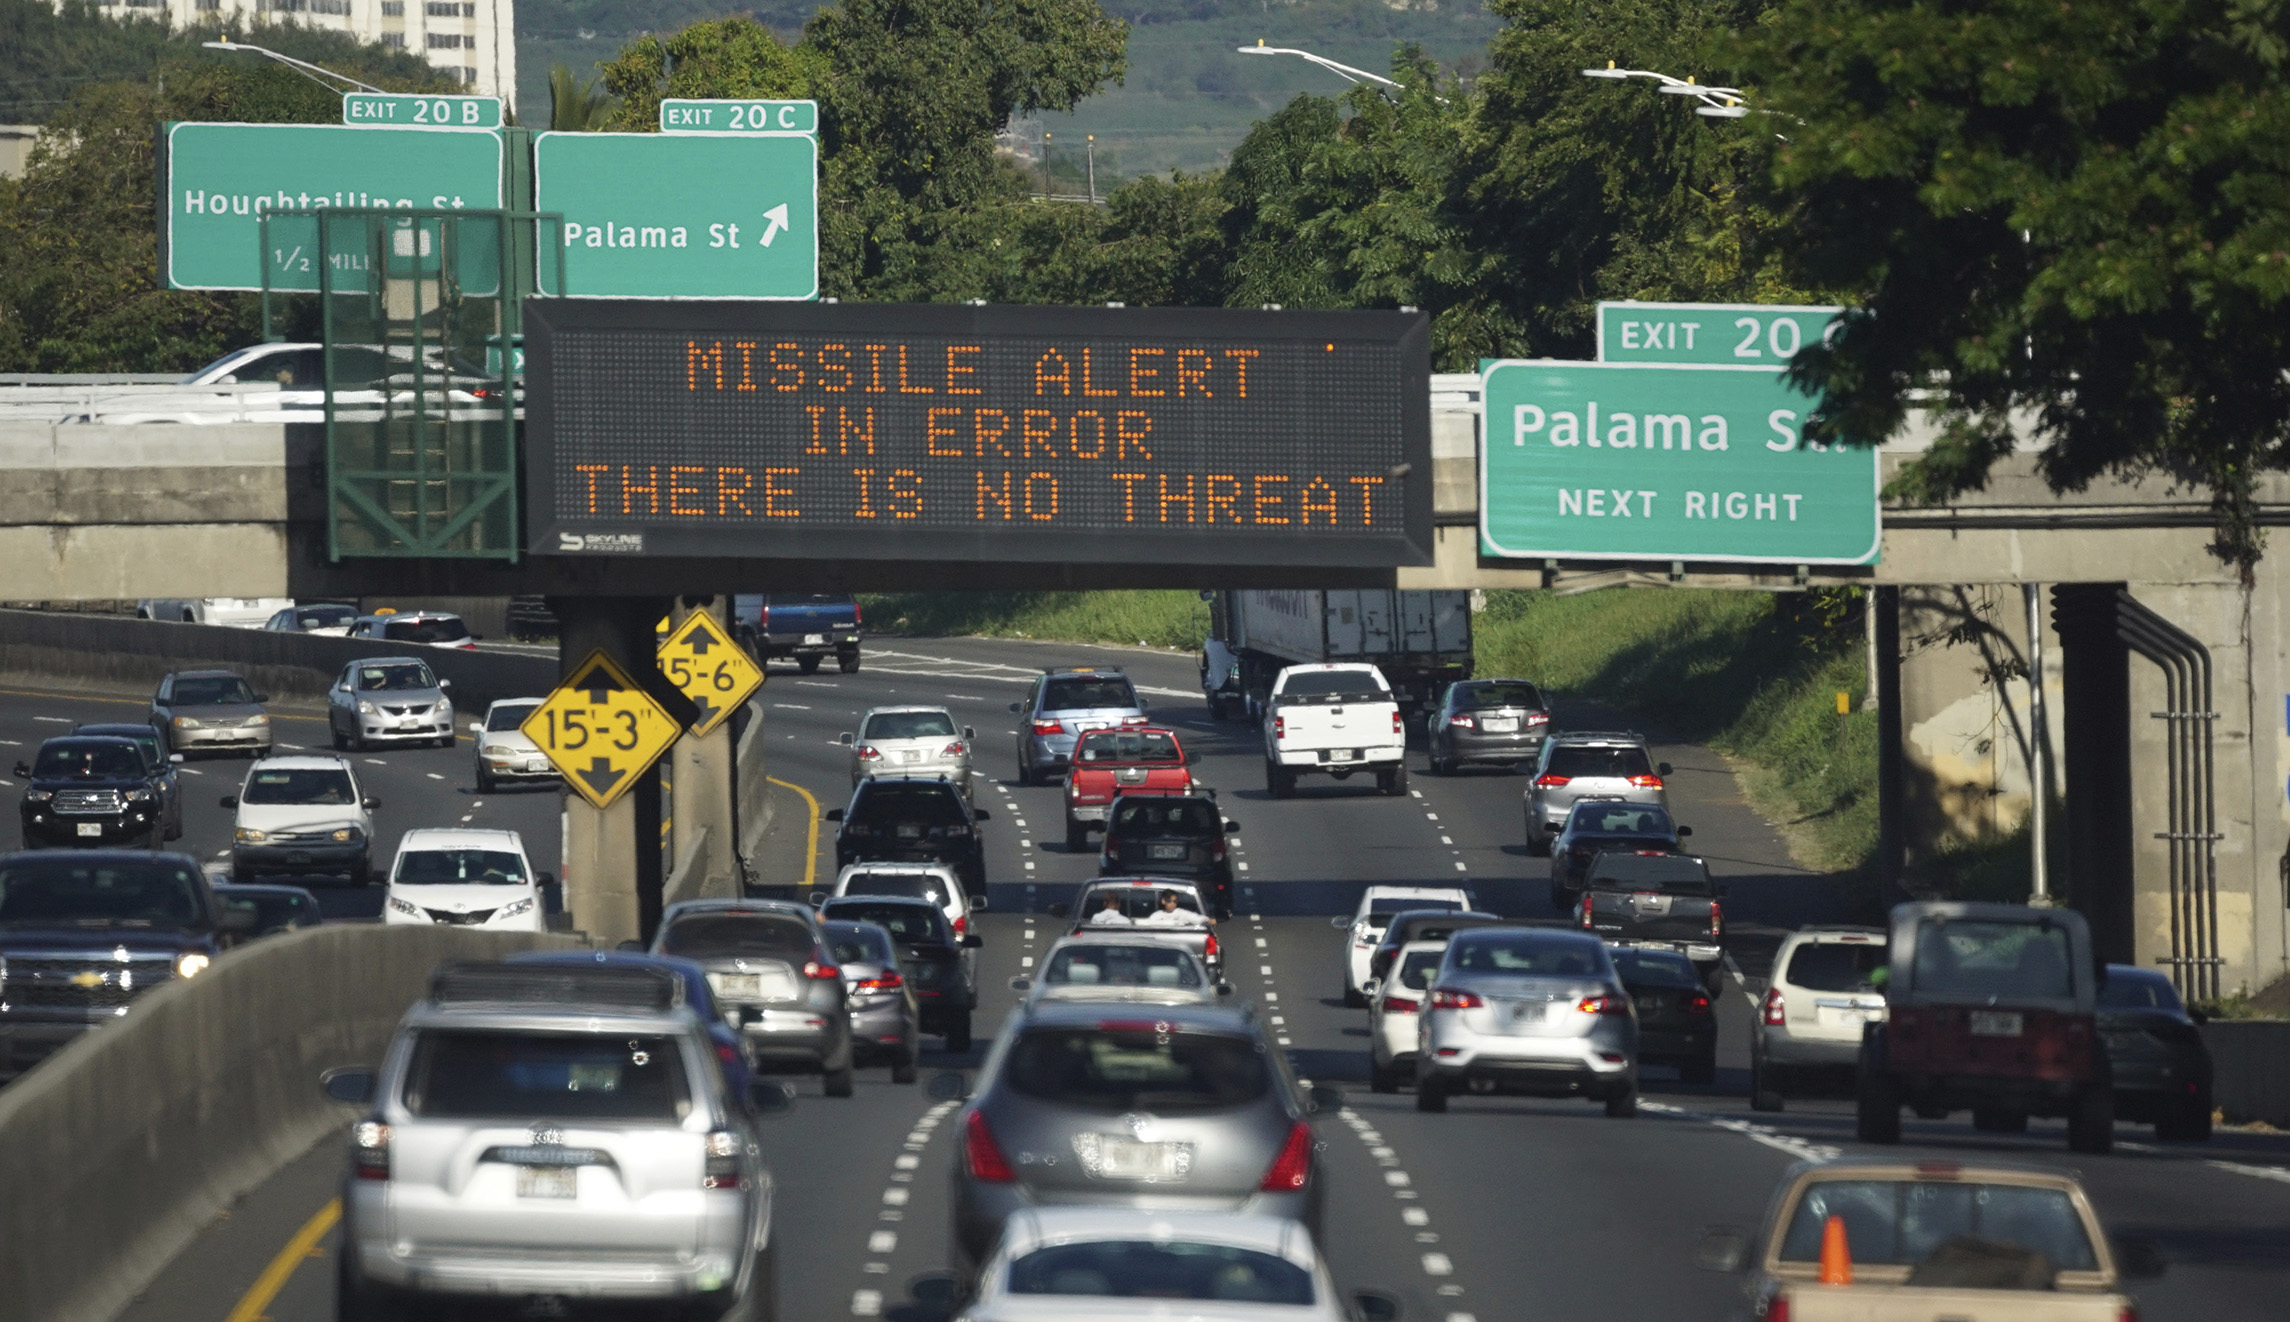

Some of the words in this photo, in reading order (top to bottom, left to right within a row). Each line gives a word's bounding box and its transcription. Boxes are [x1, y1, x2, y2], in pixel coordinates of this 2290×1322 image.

[352, 102, 396, 119] EXIT
[413, 100, 451, 124] 20
[462, 101, 480, 124] B
[668, 109, 713, 125] EXIT
[729, 105, 767, 129] 20
[778, 105, 796, 129] C
[564, 222, 688, 248] Palama
[708, 223, 740, 248] St
[1621, 321, 1700, 351] EXIT
[1734, 316, 1801, 359] 20
[687, 340, 982, 395] MISSILE
[1035, 347, 1260, 398] ALERT
[805, 405, 875, 456] IN
[927, 407, 1153, 460] ERROR
[1514, 401, 1729, 452] Palama
[575, 464, 800, 517] THERE
[853, 468, 923, 519] IS
[976, 471, 1059, 521] NO
[1112, 473, 1384, 526] THREAT
[1558, 488, 1658, 519] NEXT
[1685, 491, 1803, 521] RIGHT
